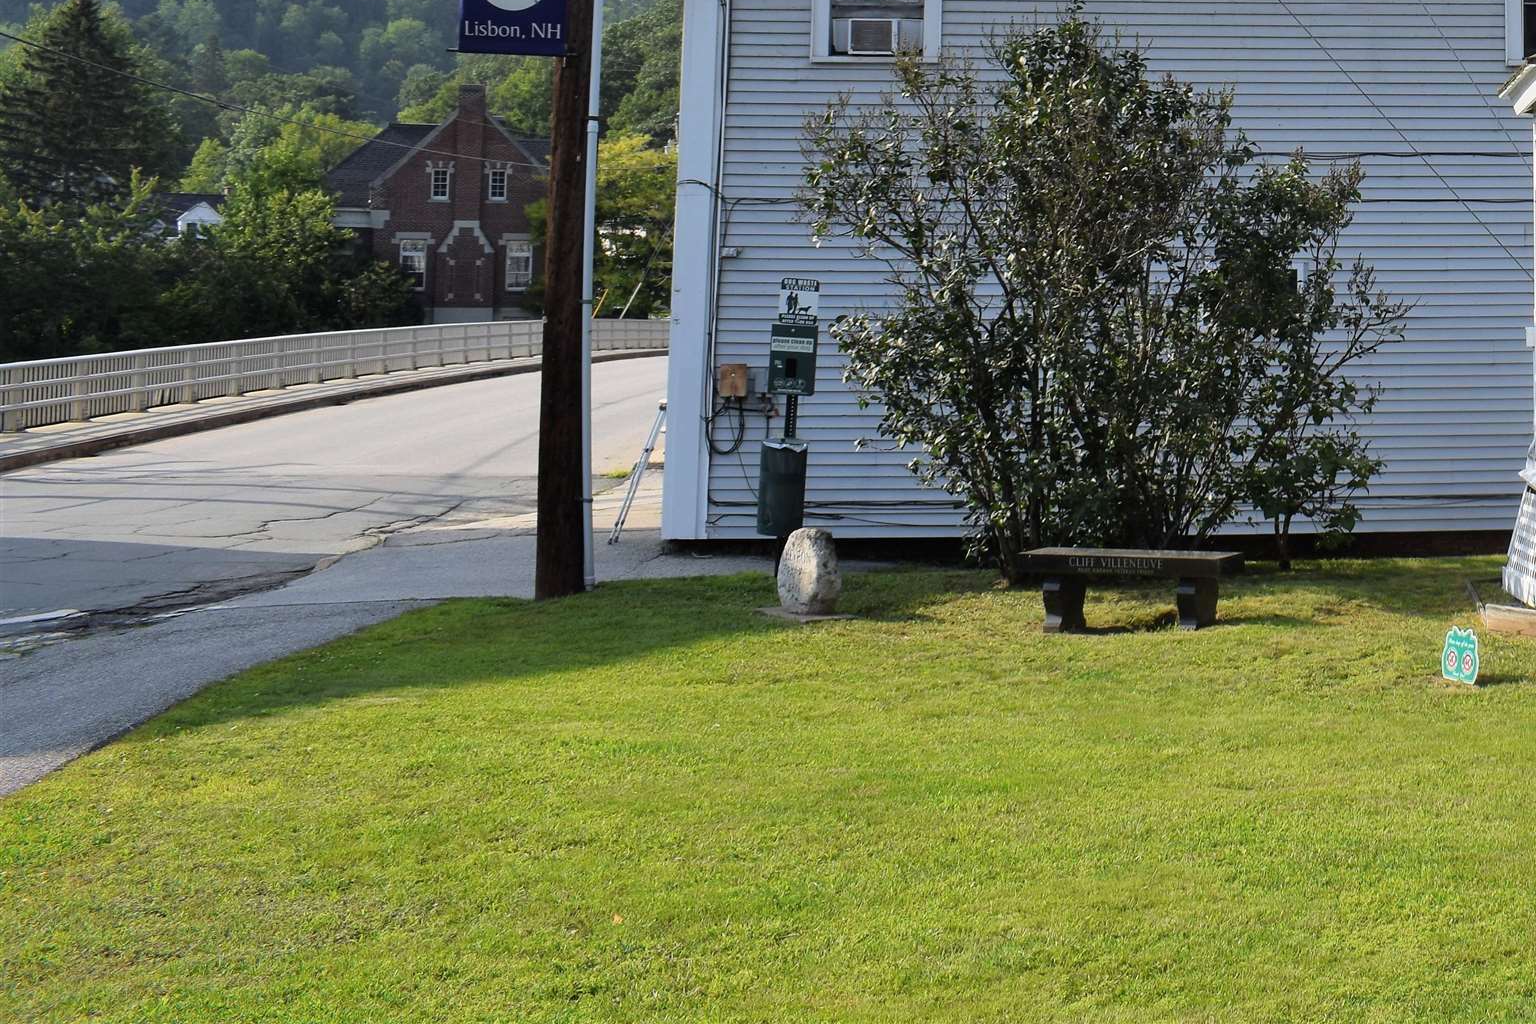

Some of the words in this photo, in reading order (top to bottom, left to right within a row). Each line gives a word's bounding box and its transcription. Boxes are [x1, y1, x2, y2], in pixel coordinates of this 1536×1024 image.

[464, 20, 526, 39] Lisbon,
[531, 22, 561, 40] NH
[1068, 557, 1095, 568] CLIFF
[1101, 557, 1163, 569] VILLENEUVE
